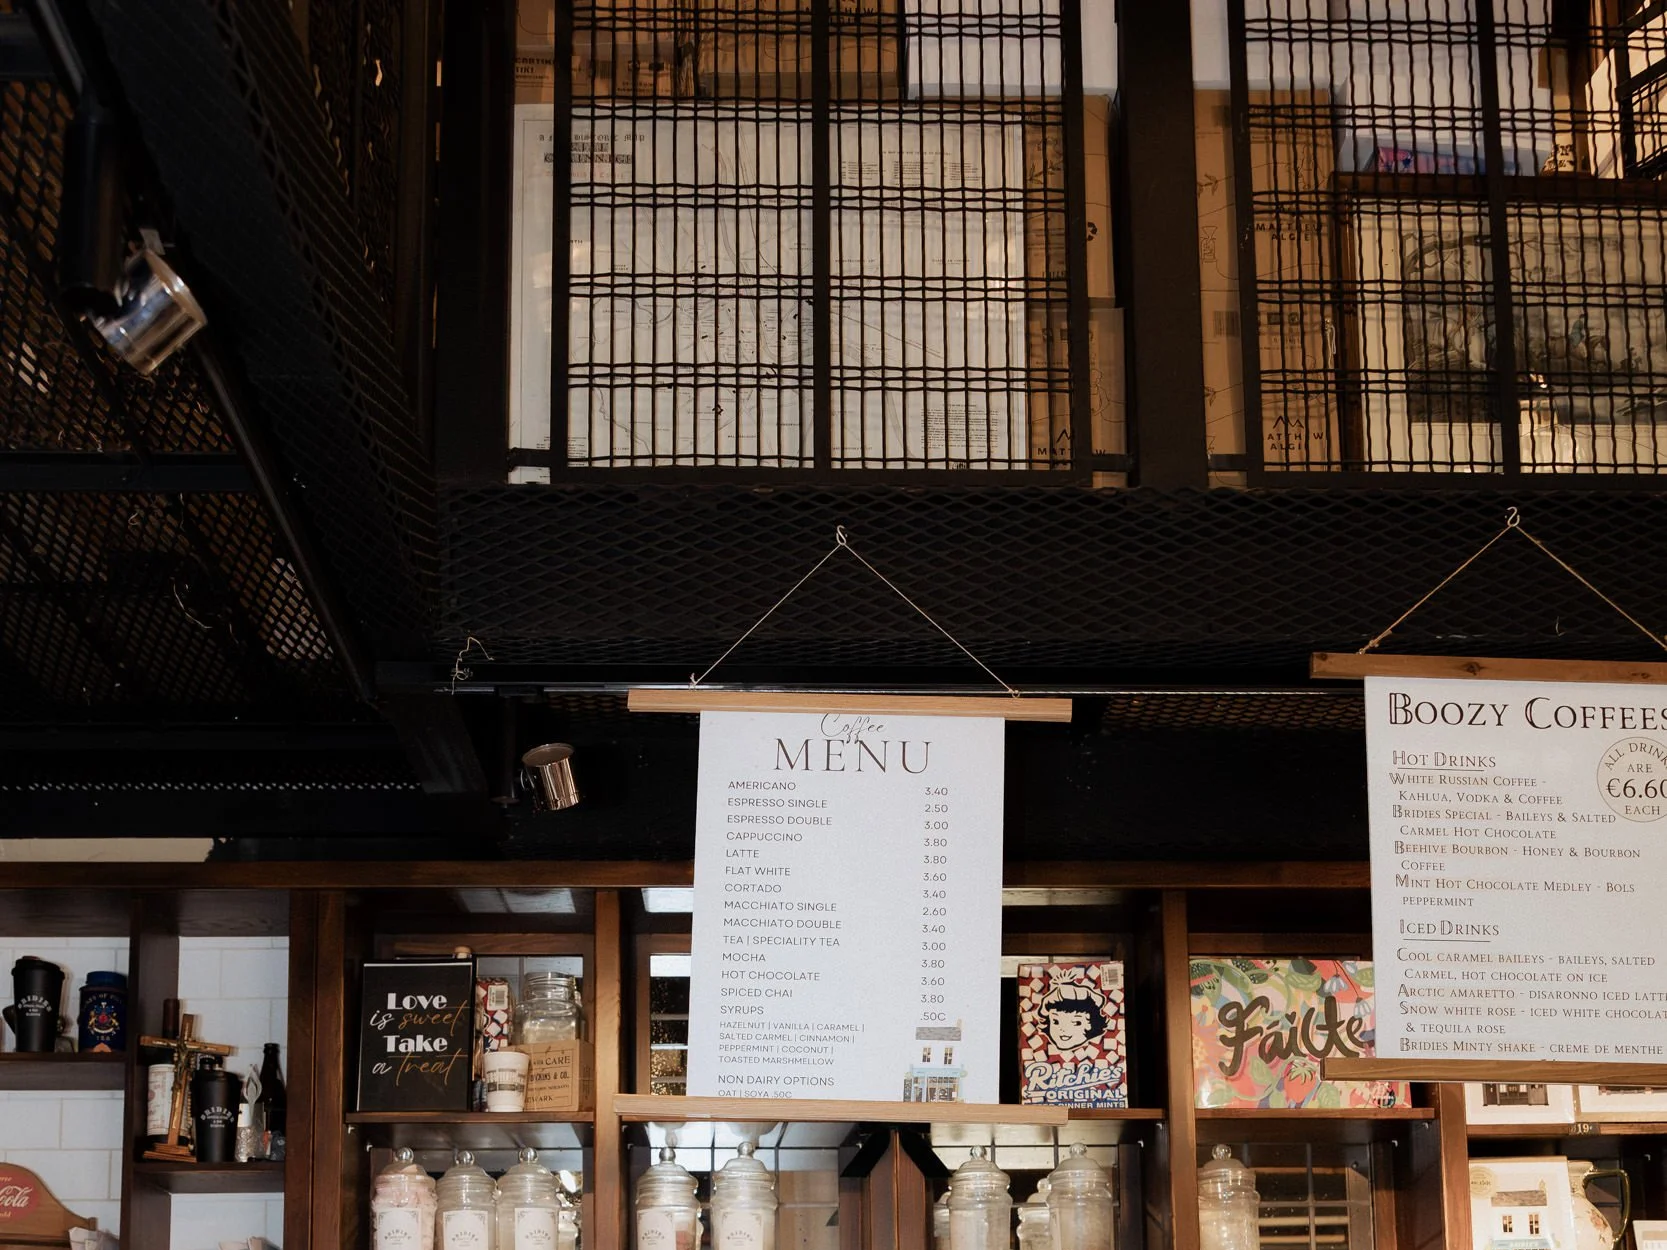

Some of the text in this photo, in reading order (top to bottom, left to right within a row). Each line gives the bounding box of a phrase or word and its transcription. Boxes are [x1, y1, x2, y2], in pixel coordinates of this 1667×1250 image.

[820, 712, 887, 744] Coffee
[774, 738, 932, 774] MENU
[1604, 750, 1624, 771] ALL
[1627, 763, 1652, 773] ARE
[728, 781, 948, 796] AMERICANO 3.40
[728, 798, 948, 813] ESPRESSO SINGLE 2.50
[1625, 805, 1660, 815] EACH
[727, 815, 949, 830] ESPRESSO DOUBLE 3.00
[727, 832, 947, 847] CAPPUCCINO 3.80
[726, 849, 947, 864] LATTE 3.80
[725, 866, 947, 881] FLAT WHITE 3.60
[724, 883, 946, 899] CORTADO 3.40
[724, 901, 947, 916] MACCHIATO SINGLE 2.60
[1403, 897, 1473, 907] PEPPERMINT
[724, 918, 946, 934] MACCHIATO DOUBLE 3.40
[723, 936, 946, 951] TEA SPECIALITY TEA 3.00
[722, 953, 945, 968] MOCHA 3.80
[1437, 953, 1493, 963] CARAMEL
[1498, 954, 1544, 964] BAILEYS
[1611, 956, 1655, 966] SALTED
[721, 970, 945, 986] HOT CHOCOLATE 3.60
[1462, 971, 1486, 980] HOT
[1491, 971, 1562, 982] CHOCOLATE
[387, 993, 447, 1010] Love
[721, 988, 944, 1003] SPICED CHAI 3.80
[1450, 988, 1515, 998] AMARETTO
[1529, 990, 1597, 1000] DISARONNO
[1603, 991, 1629, 1001] ICED
[370, 1000, 470, 1037] is sweet
[720, 1005, 946, 1021] SYRUPS .50C
[1444, 1006, 1482, 1016] WHITE
[1488, 1007, 1516, 1016] ROSE
[1530, 1008, 1557, 1017] ICED
[1563, 1008, 1601, 1018] WHITE
[720, 1022, 861, 1032] HAZELNUT VANILLA CARAMEL
[1421, 1024, 1506, 1034] TEQUILA ROSE
[719, 1033, 850, 1043] SALTED CARMEL CINNAMON
[1218, 995, 1364, 1076] Fáilte
[383, 1035, 448, 1053] Take
[719, 1045, 828, 1054] PEPPERMINT COCONUT
[1498, 1043, 1535, 1052] SHAKE
[1550, 1044, 1589, 1053] CREME
[1615, 1045, 1663, 1054] MENTHE
[372, 1062, 392, 1075] a
[396, 1048, 468, 1086] treat
[546, 1056, 571, 1066] CARE
[718, 1056, 834, 1066] TOASTED MARSHMELLOW
[718, 1075, 834, 1086] NON DAIRY OPTIONS
[1024, 1062, 1123, 1091] Ritchie's
[1045, 1089, 1124, 1101] ORIGINAL
